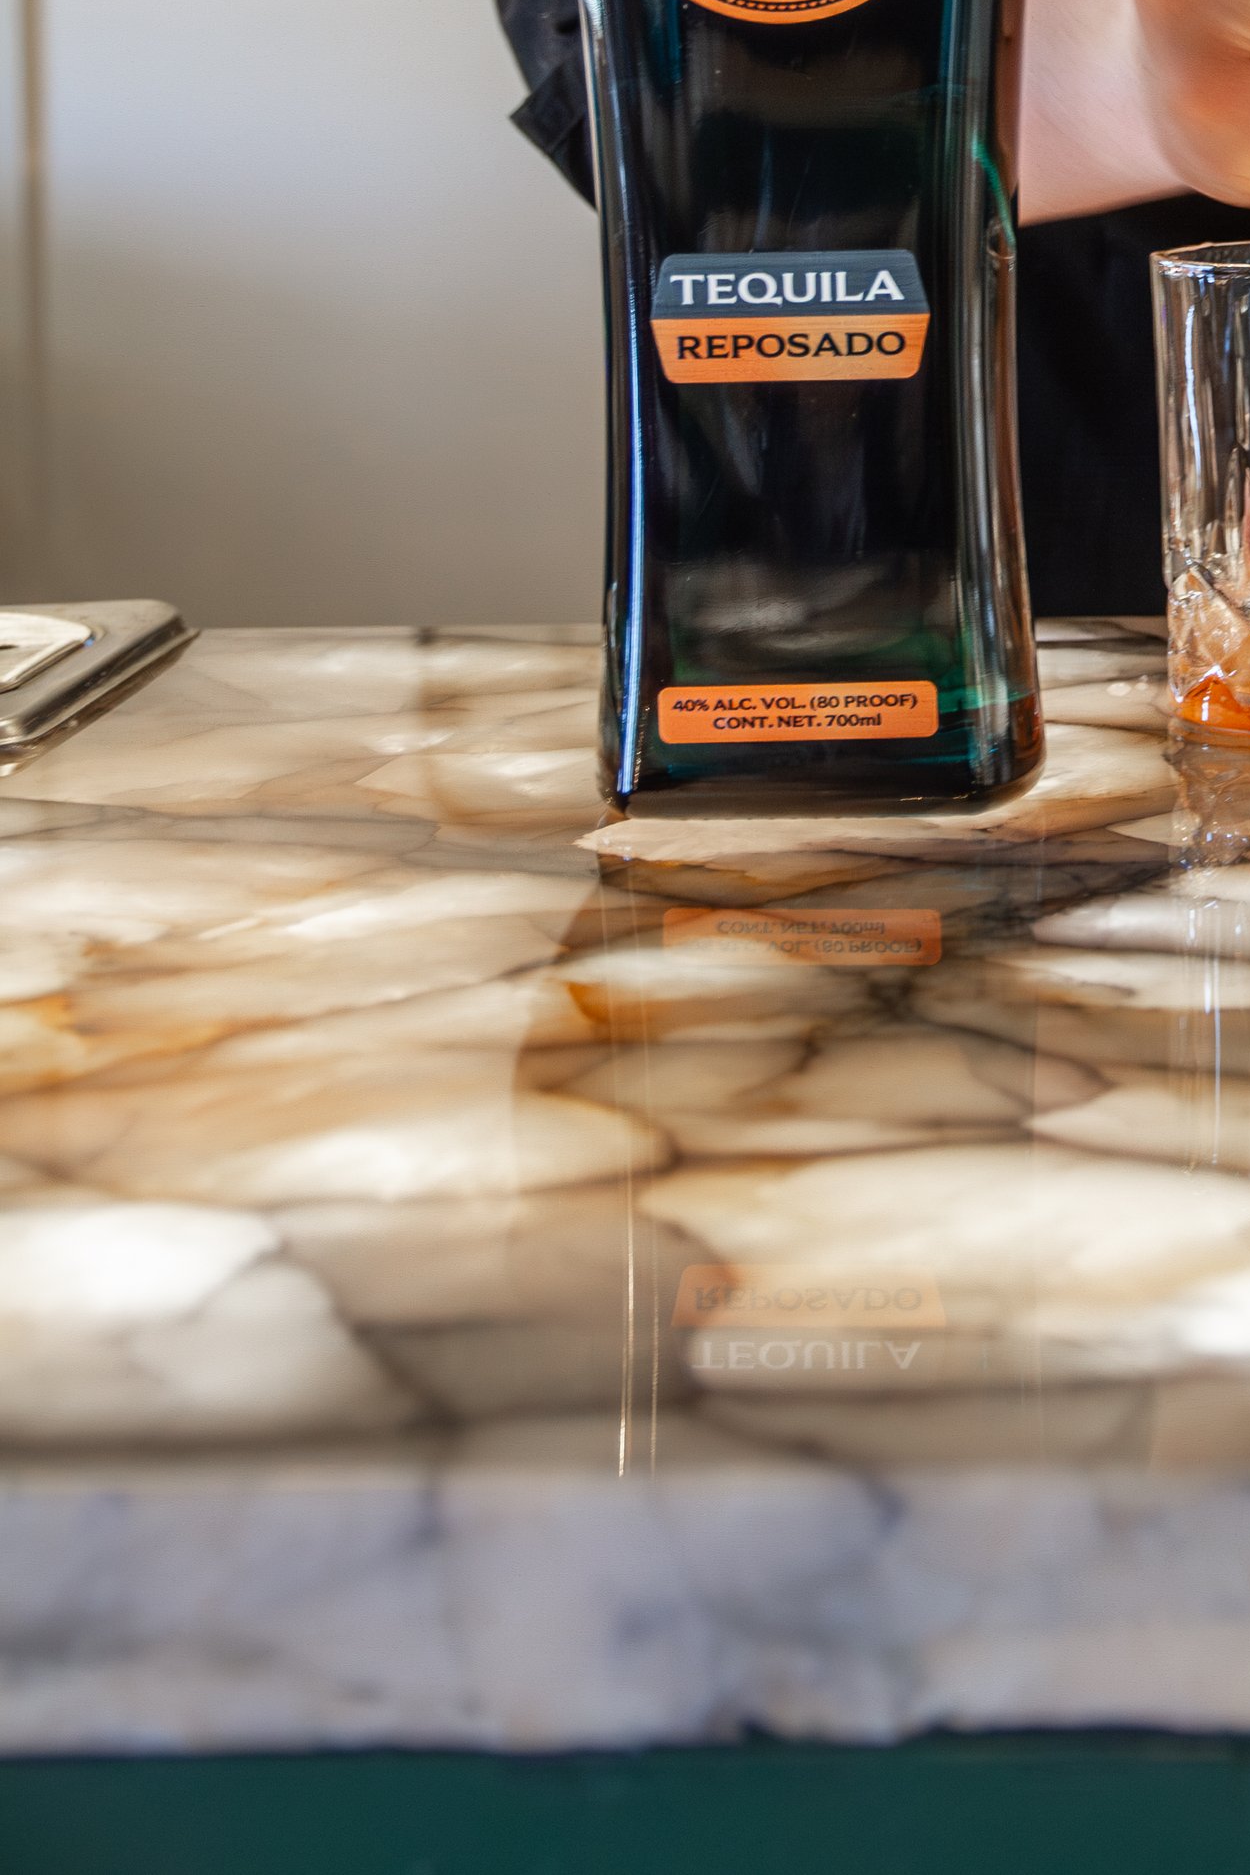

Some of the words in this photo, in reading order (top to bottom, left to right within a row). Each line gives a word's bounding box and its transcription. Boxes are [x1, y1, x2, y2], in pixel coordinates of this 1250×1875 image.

[669, 269, 905, 308] TEQUILA
[676, 330, 907, 360] REPOSADO
[672, 698, 709, 713] 40%
[712, 697, 757, 712] ALC.
[760, 696, 806, 711] VOL.
[809, 694, 840, 712] (80
[844, 692, 919, 710] PROOF)
[712, 716, 774, 731] CONT.
[776, 714, 822, 729] NET.
[825, 713, 883, 727] 700ml
